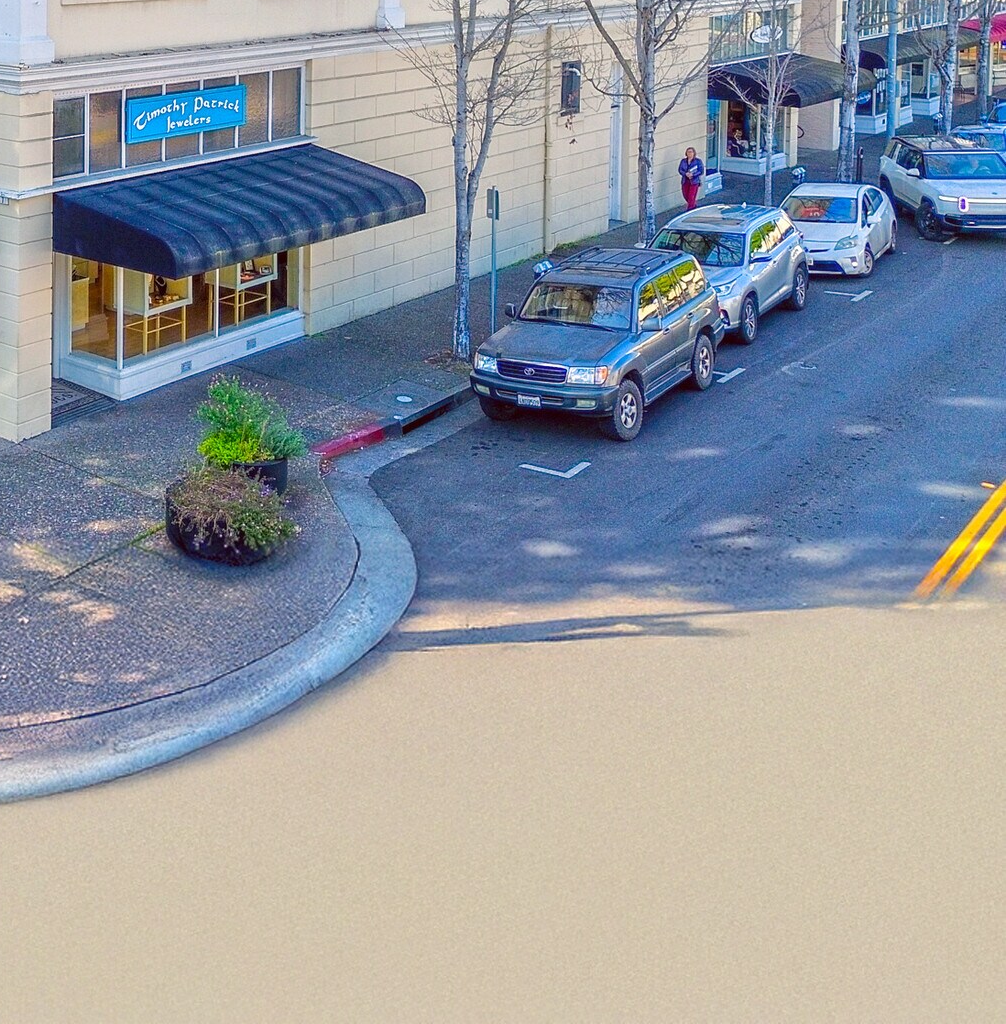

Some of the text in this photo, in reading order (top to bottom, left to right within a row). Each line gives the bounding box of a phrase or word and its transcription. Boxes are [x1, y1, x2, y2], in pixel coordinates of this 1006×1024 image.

[133, 96, 240, 131] Timothy Patrick
[167, 115, 212, 133] Jewelers
